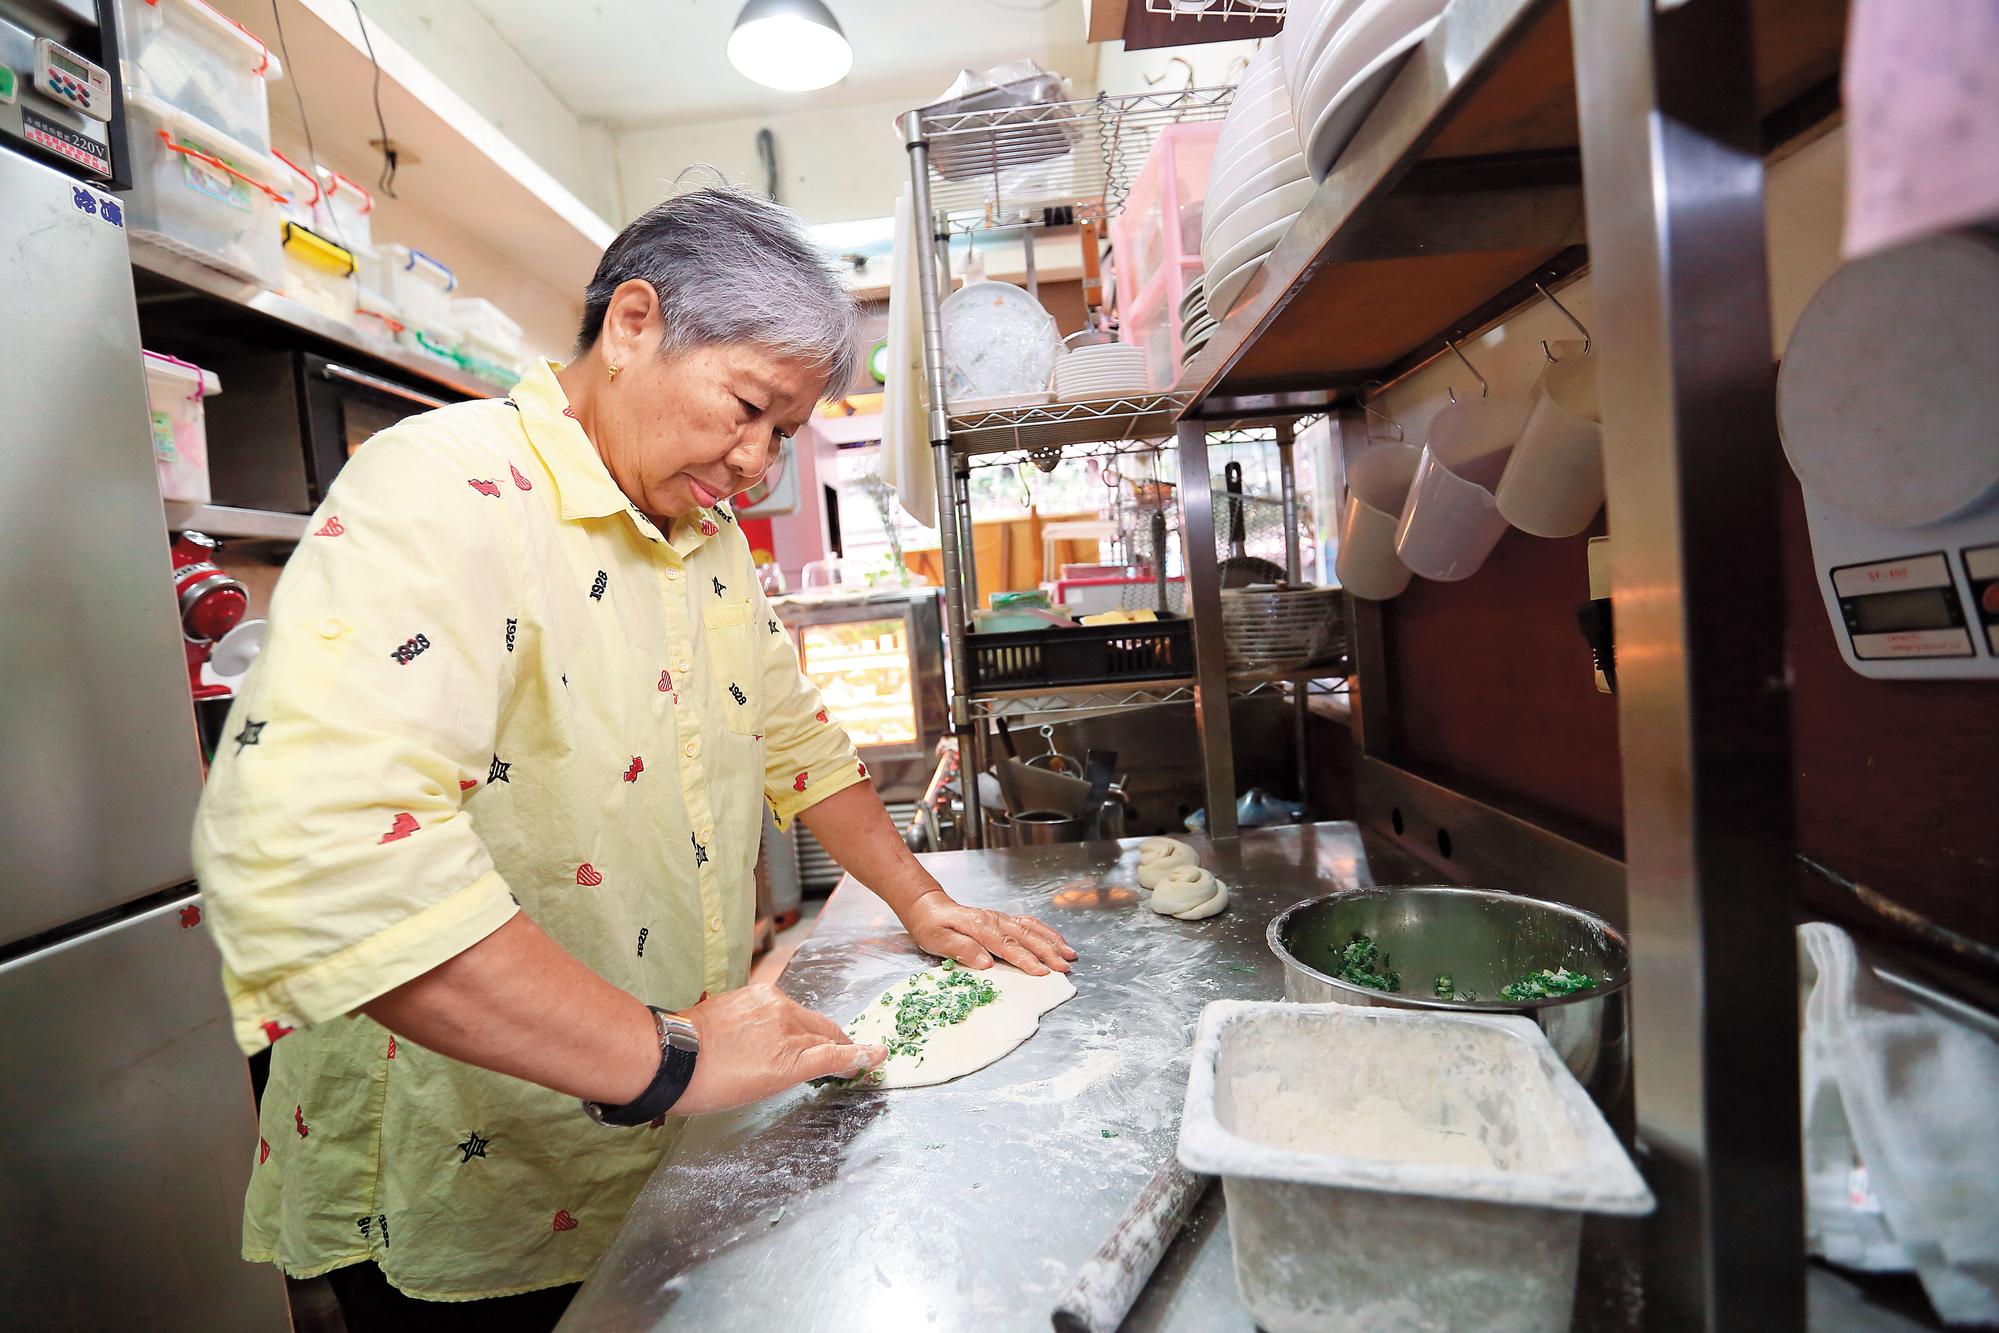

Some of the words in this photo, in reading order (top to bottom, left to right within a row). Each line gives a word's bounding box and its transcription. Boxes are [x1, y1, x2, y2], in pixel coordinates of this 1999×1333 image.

[72, 134, 105, 157] 220V
[72, 186, 123, 228] 冷凍
[589, 570, 608, 602] 1928
[391, 633, 430, 665] 1928
[729, 682, 747, 706] 1928
